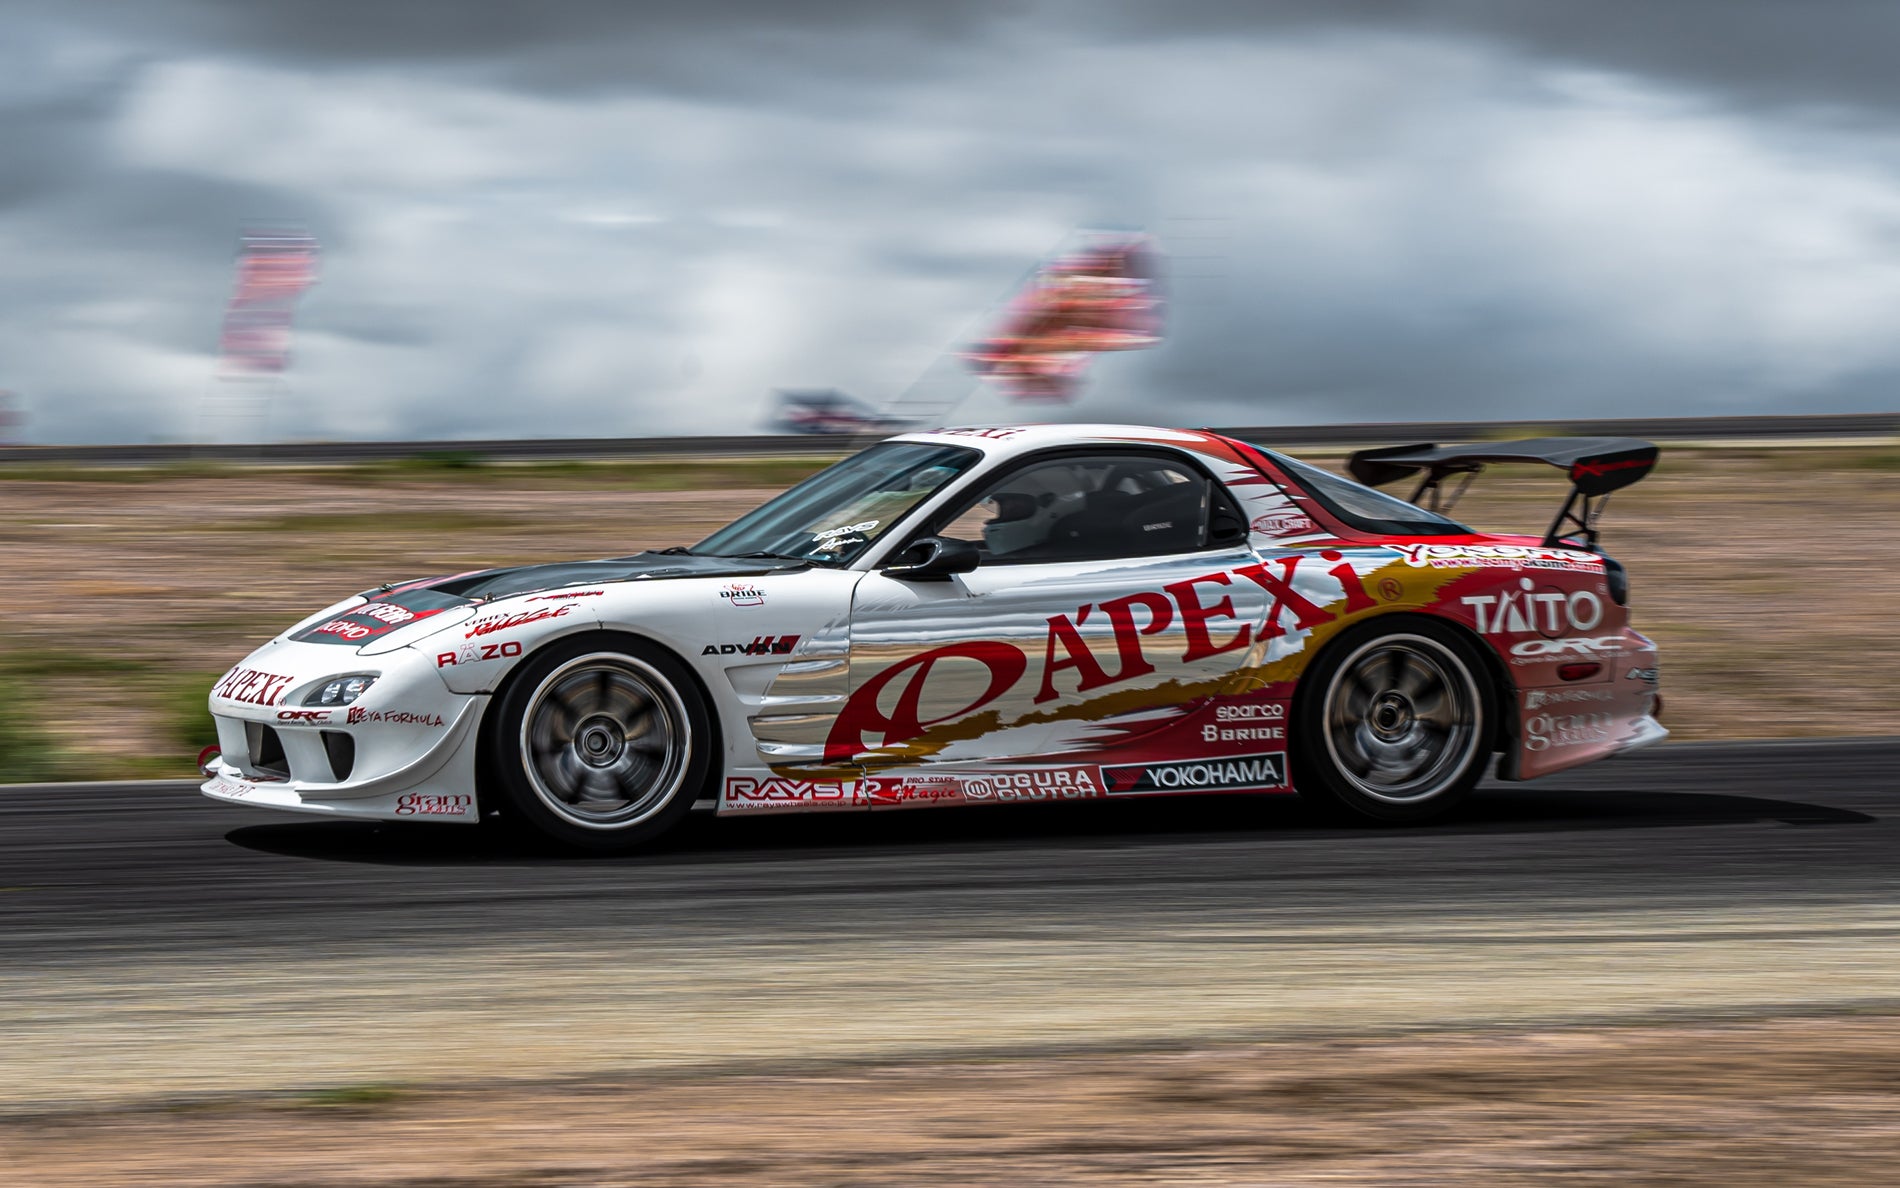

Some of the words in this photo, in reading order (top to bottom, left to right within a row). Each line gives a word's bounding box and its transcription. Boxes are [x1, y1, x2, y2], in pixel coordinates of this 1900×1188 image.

[701, 642, 791, 656] ADVAN
[1216, 704, 1284, 722] sparco
[1220, 727, 1285, 740] BRIDE
[1147, 758, 1280, 788] YOKOHAMA
[727, 777, 844, 800] RAYS
[997, 785, 1097, 800] CLUTCH
[395, 792, 471, 816] gram
